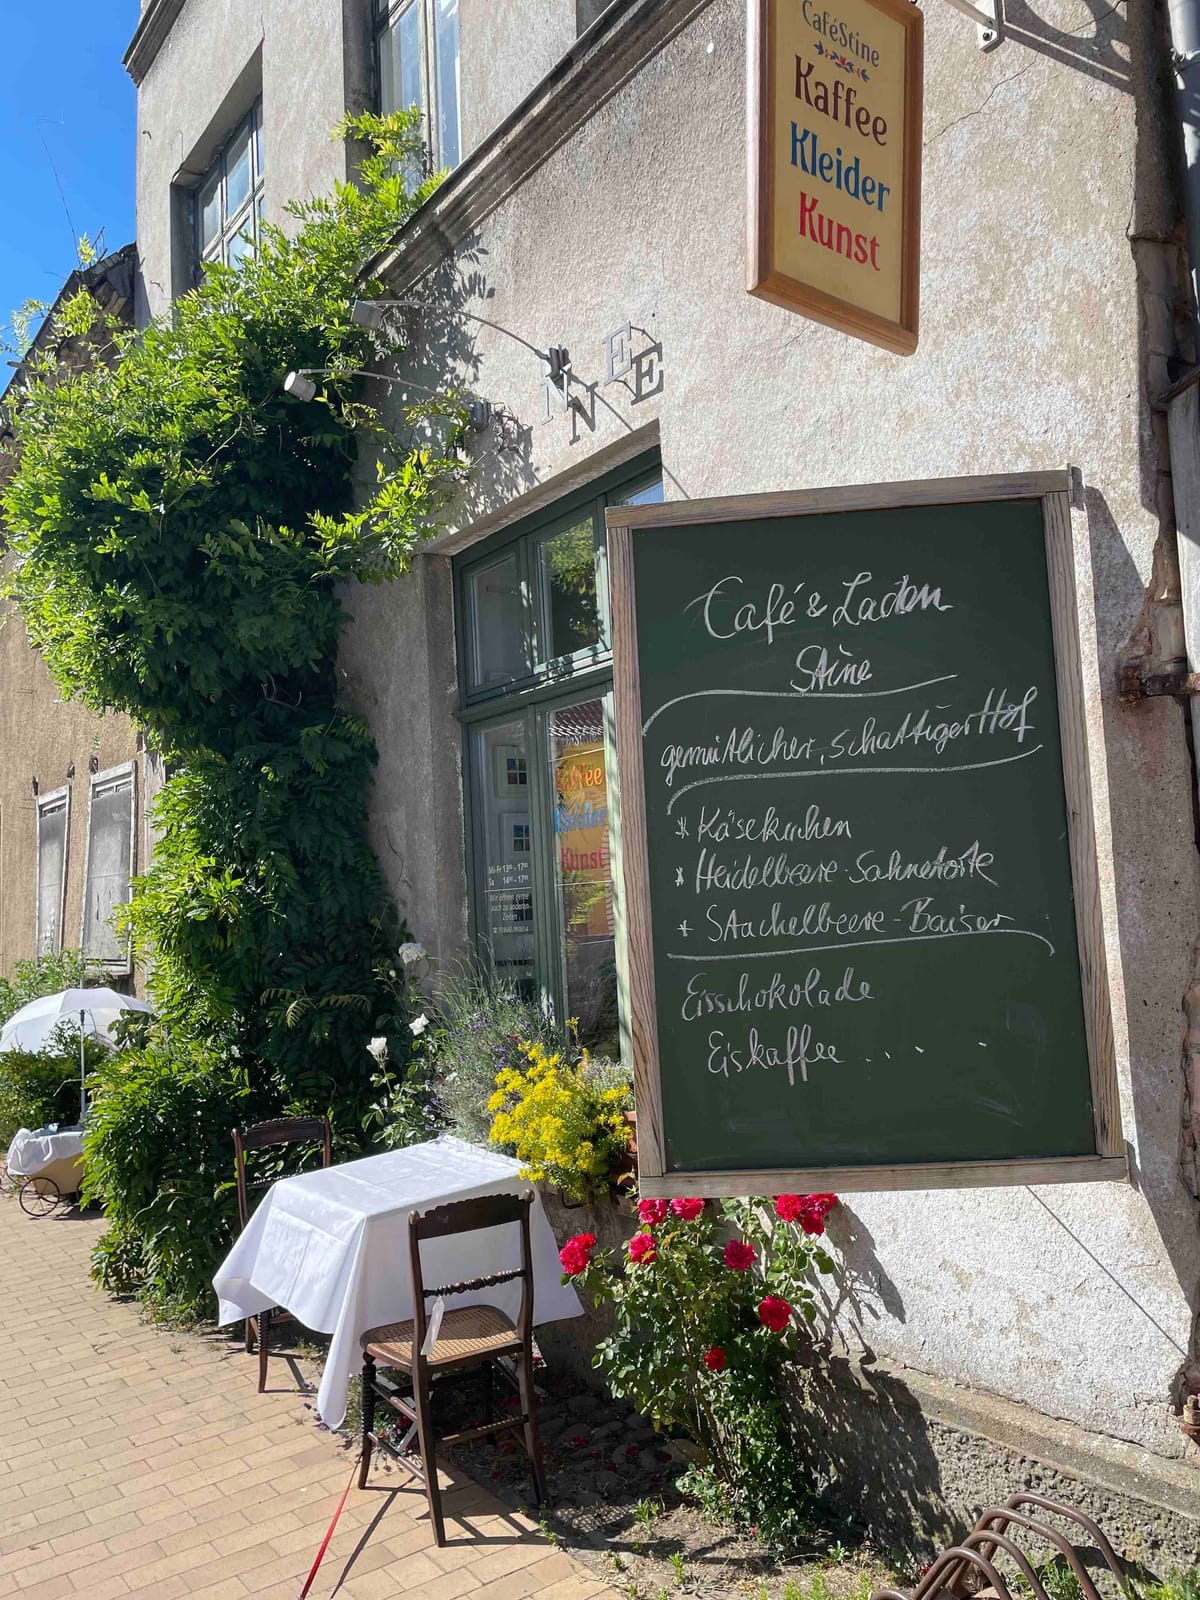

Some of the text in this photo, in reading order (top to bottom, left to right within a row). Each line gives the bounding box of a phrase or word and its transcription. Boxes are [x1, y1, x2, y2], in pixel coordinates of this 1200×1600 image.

[794, 54, 887, 146] Kaffee
[790, 121, 890, 212] Kleider
[798, 191, 880, 271] Kunst
[702, 576, 804, 644] Café
[806, 592, 827, 618] &
[790, 644, 872, 694] Stine
[970, 686, 1037, 743] Hof
[697, 804, 851, 843] Käsekuchen
[488, 878, 495, 887] Sa
[561, 848, 606, 873] Kunst
[681, 967, 876, 1021] Eisschokolade
[708, 1024, 846, 1086] Eiskaffee
